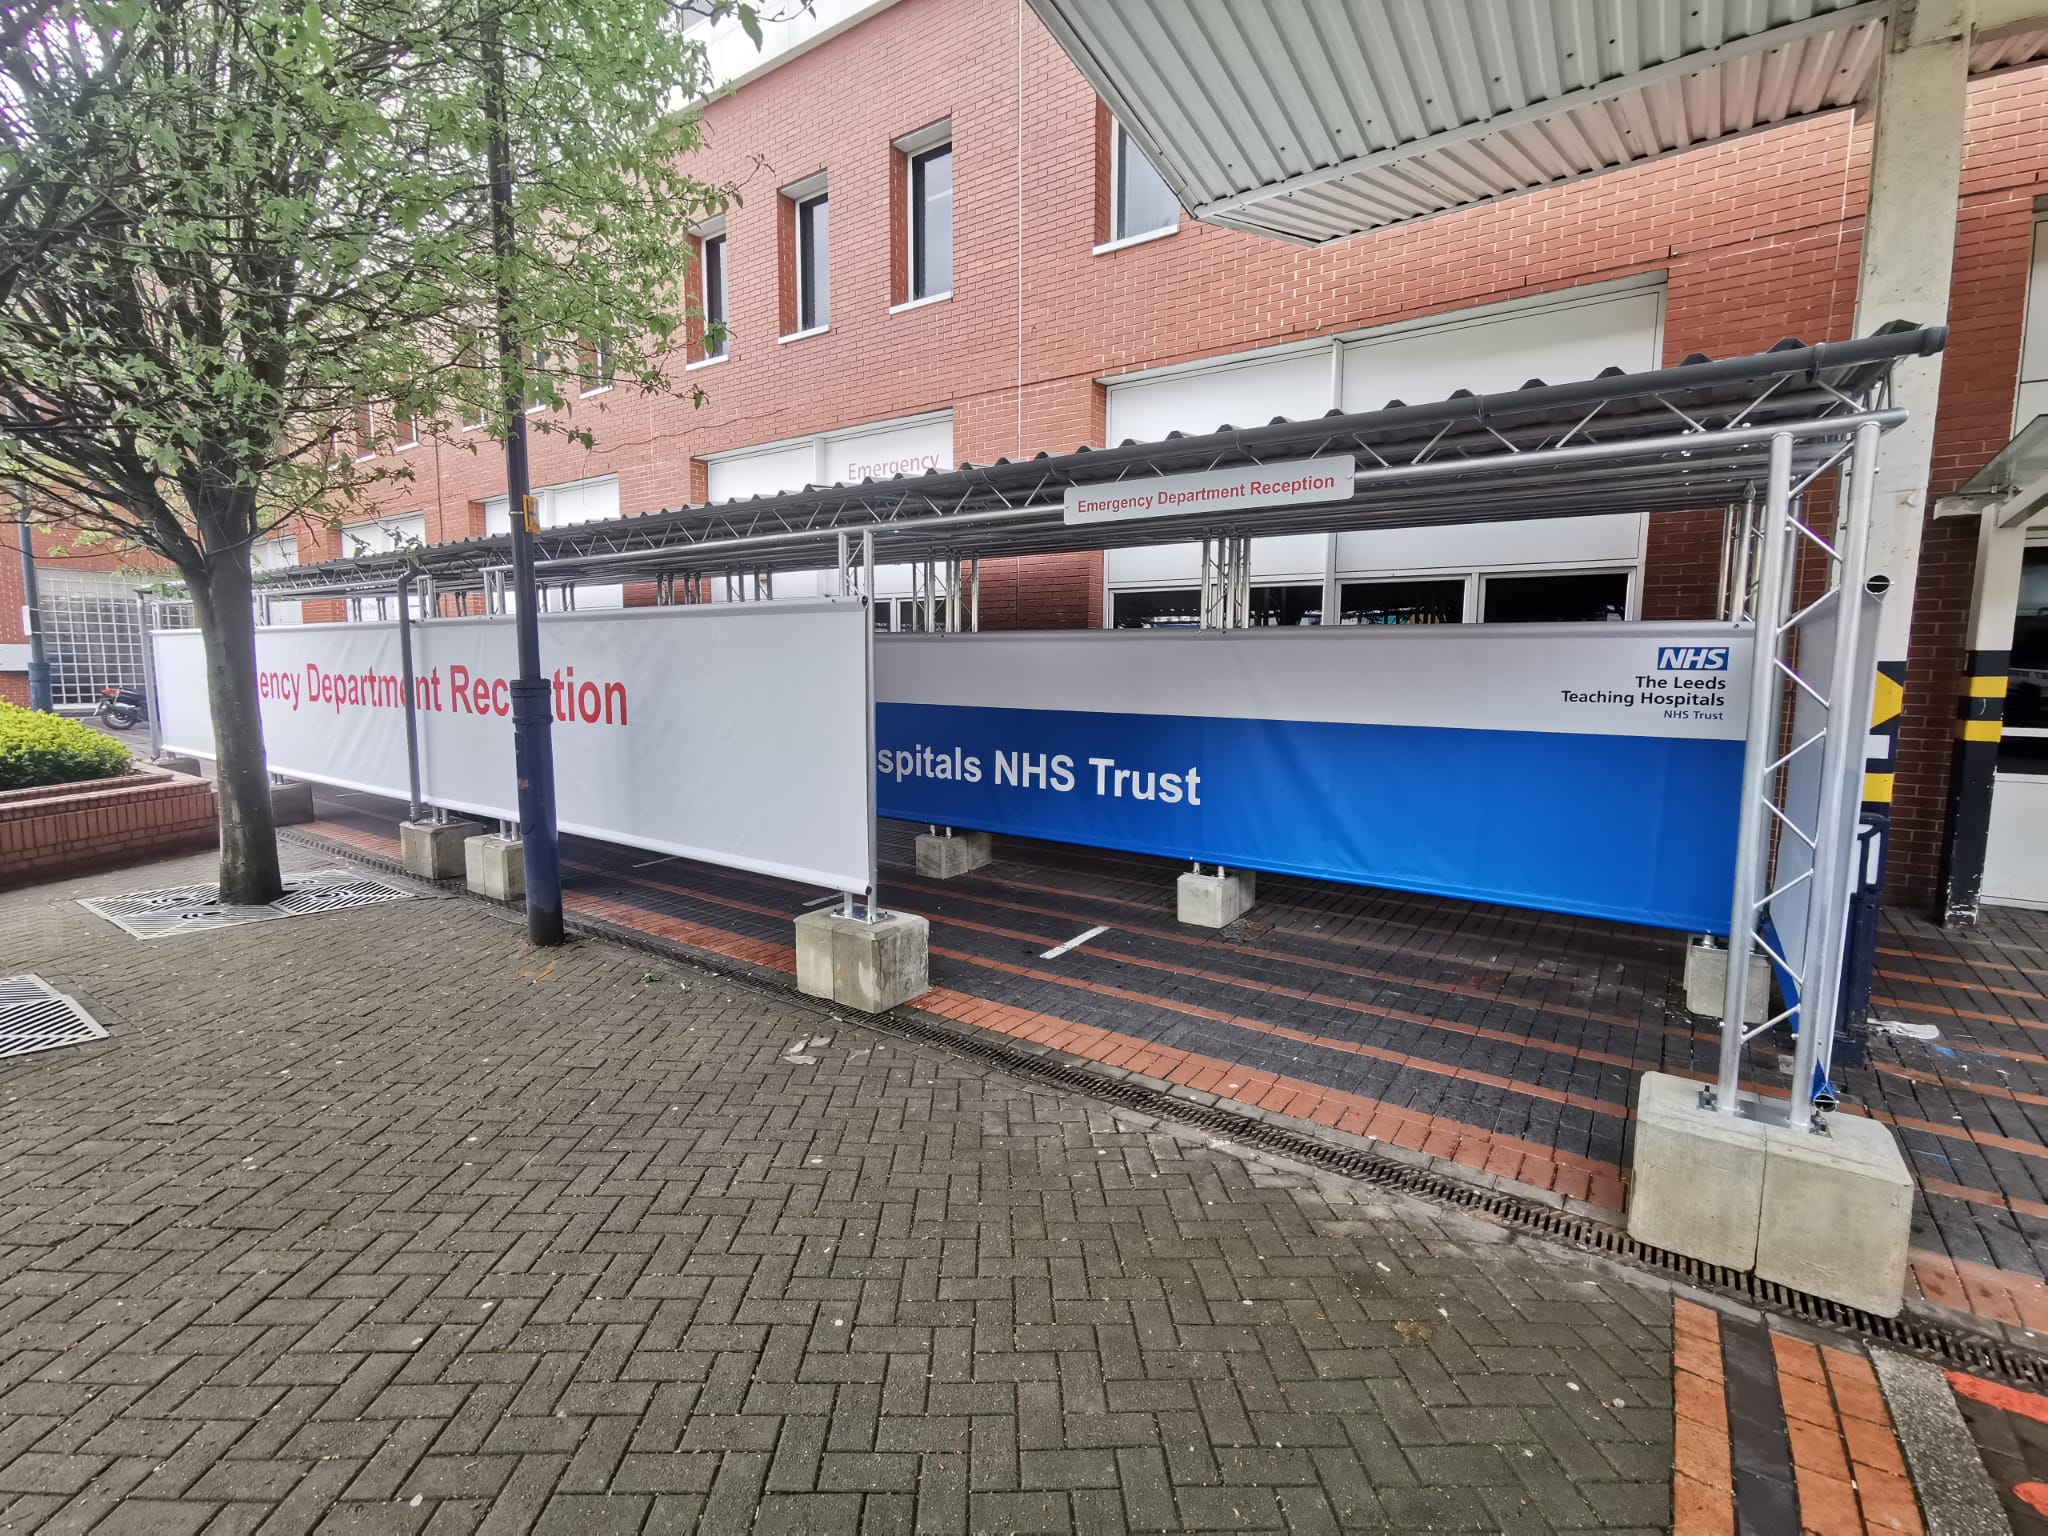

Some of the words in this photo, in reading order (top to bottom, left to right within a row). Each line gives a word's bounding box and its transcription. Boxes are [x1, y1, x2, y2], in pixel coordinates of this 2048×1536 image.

[848, 453, 940, 480] Emergency
[1077, 493, 1154, 513] Emergency
[1157, 483, 1246, 506] Department
[1250, 474, 1335, 495] Reception
[1658, 648, 1727, 670] NHS
[1635, 675, 1668, 689] The
[1673, 676, 1726, 690] Leeds
[450, 664, 628, 726] Rection
[1561, 690, 1635, 707] Teaching
[1640, 692, 1725, 708] Hospitals
[1663, 710, 1689, 719] NHS
[1693, 710, 1724, 720] Trust
[877, 743, 983, 783] spitals
[994, 750, 1076, 792] NHS
[1088, 757, 1201, 806] Trust
